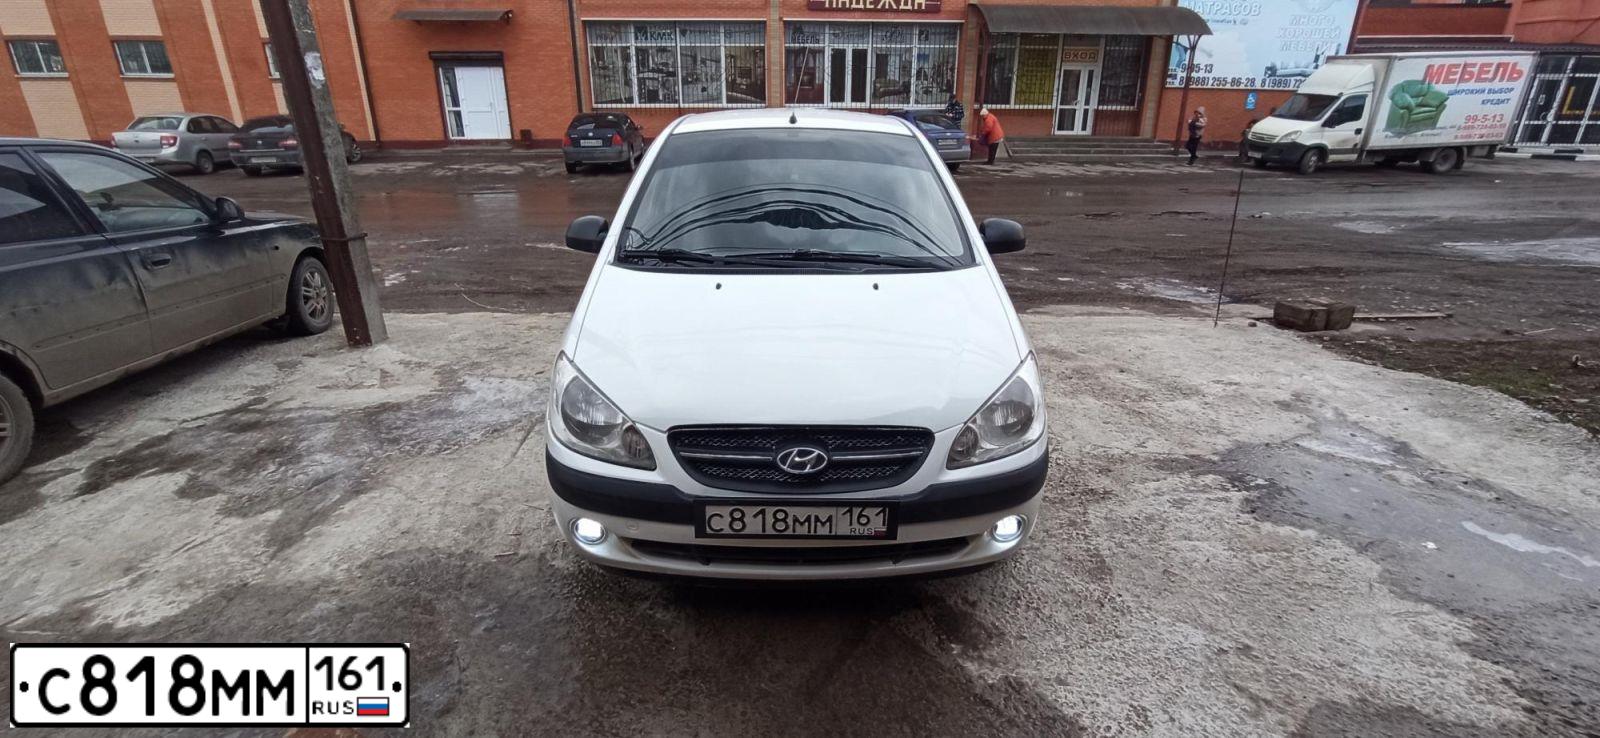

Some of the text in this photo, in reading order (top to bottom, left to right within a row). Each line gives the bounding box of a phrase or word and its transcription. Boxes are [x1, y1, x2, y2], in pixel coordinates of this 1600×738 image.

[1289, 15, 1336, 26] МНОГО
[1279, 25, 1342, 39] ХОРОШЕЙ
[1064, 51, 1096, 60] ВХОД
[1423, 62, 1524, 85] МЕБЕЛЬ
[1260, 78, 1267, 88] 8
[1447, 87, 1515, 96] ШИРОКИЙ ВЫБОР
[1464, 113, 1504, 124] 99-5-13
[841, 507, 888, 527] 161
[849, 527, 873, 536] RUS
